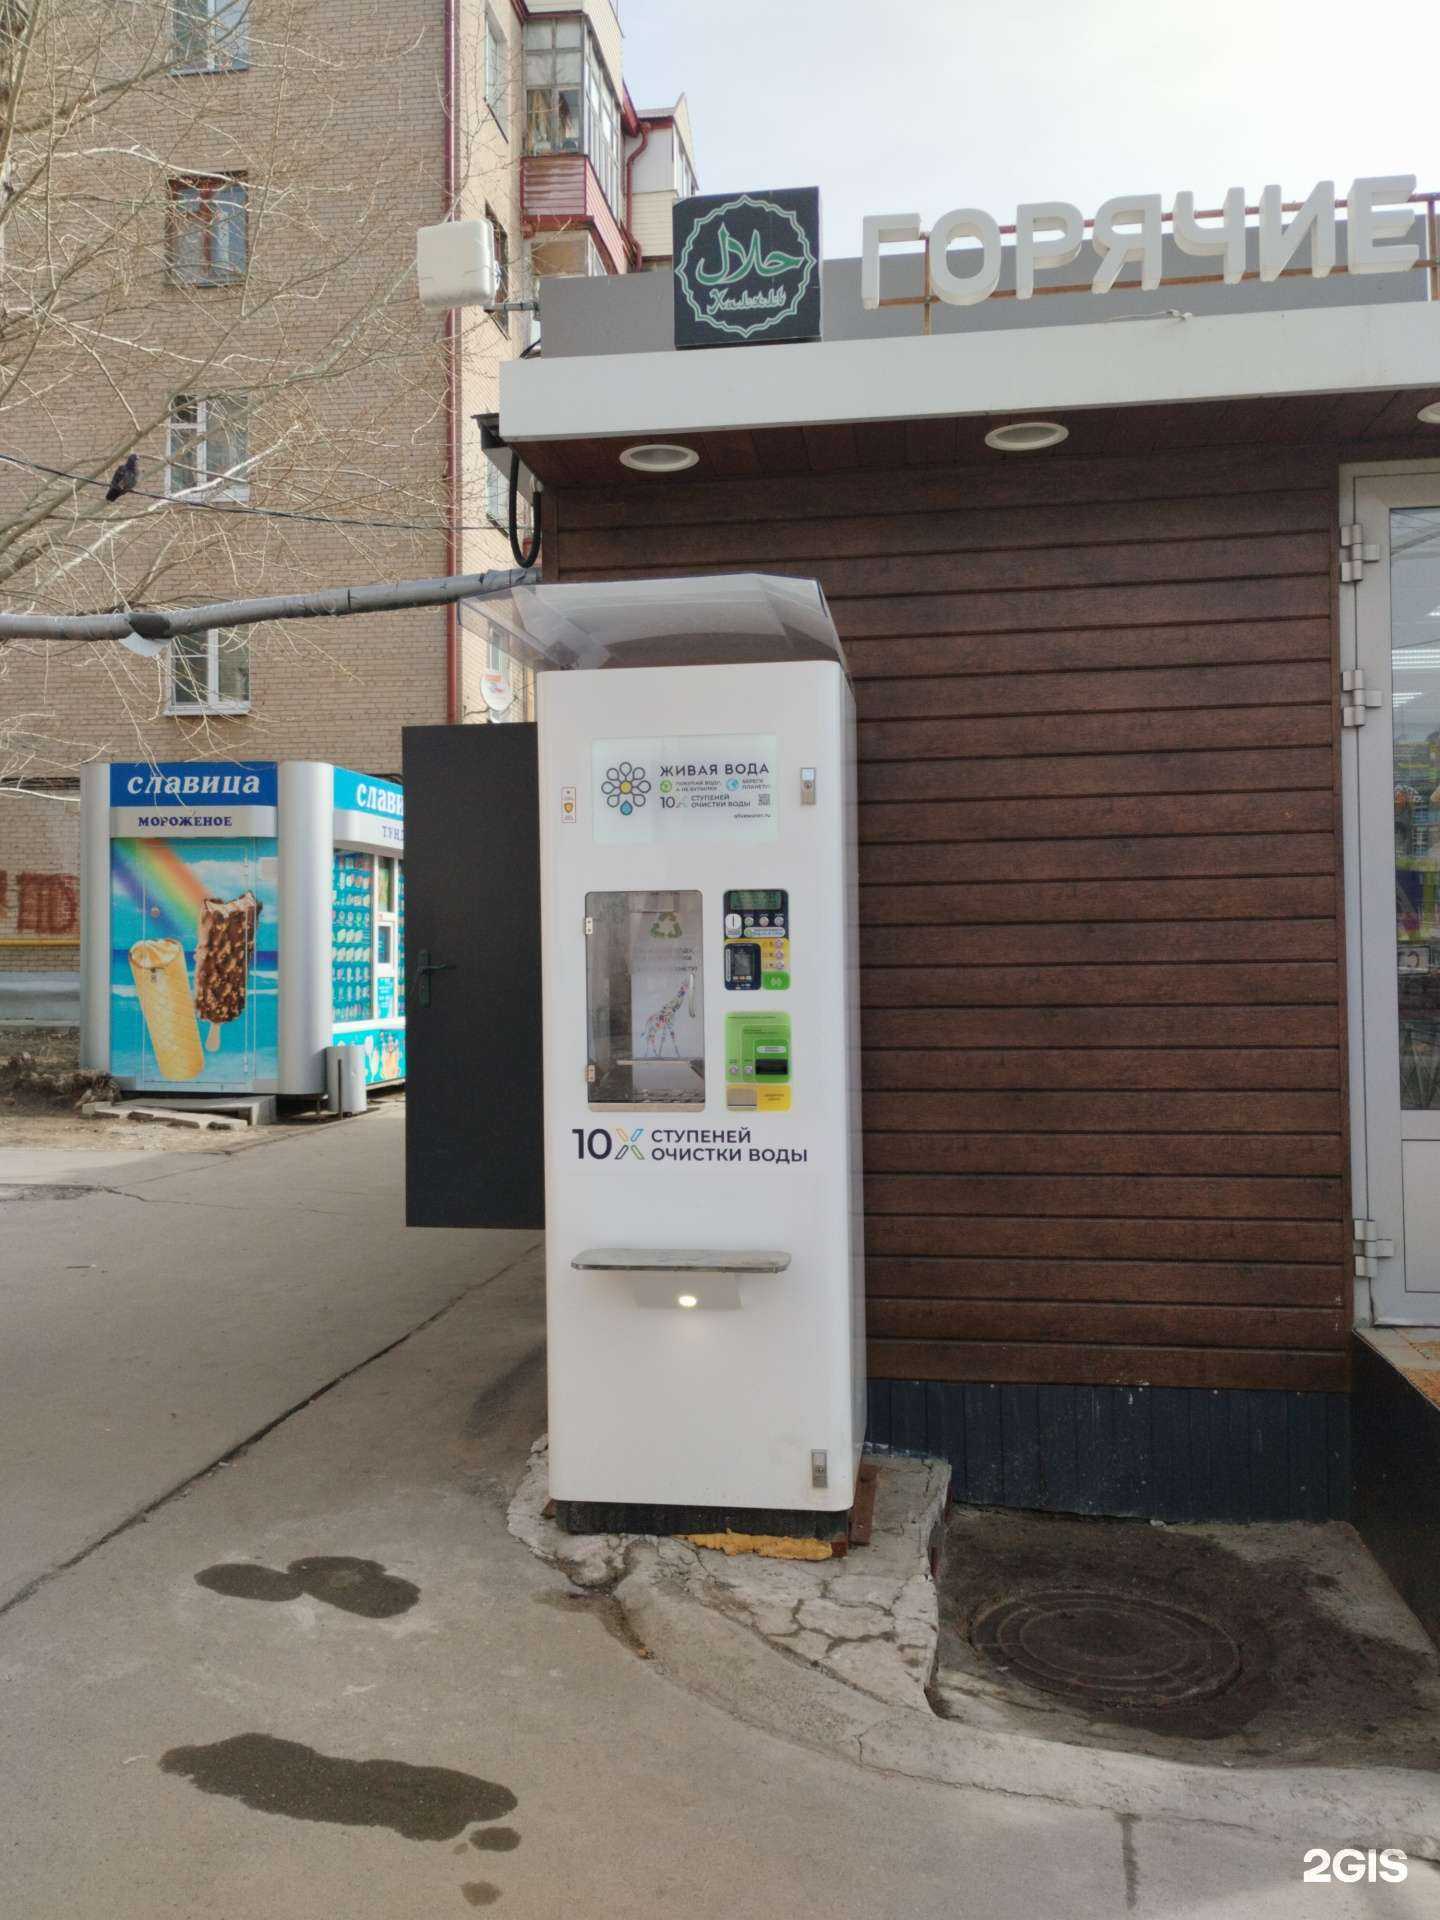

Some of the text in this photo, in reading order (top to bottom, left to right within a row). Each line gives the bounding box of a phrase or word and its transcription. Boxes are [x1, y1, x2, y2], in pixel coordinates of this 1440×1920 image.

[861, 174, 1419, 309] ГОРЯЧИЕ
[695, 222, 805, 286] حلال
[659, 763, 770, 777] ЖИВАЯ ВОДА
[138, 815, 233, 827] МОРОЖЕНОЕ
[651, 1127, 751, 1144] СТУПЕНЕЙ
[651, 1147, 808, 1164] ОЧИСТКИ ВОДЫ
